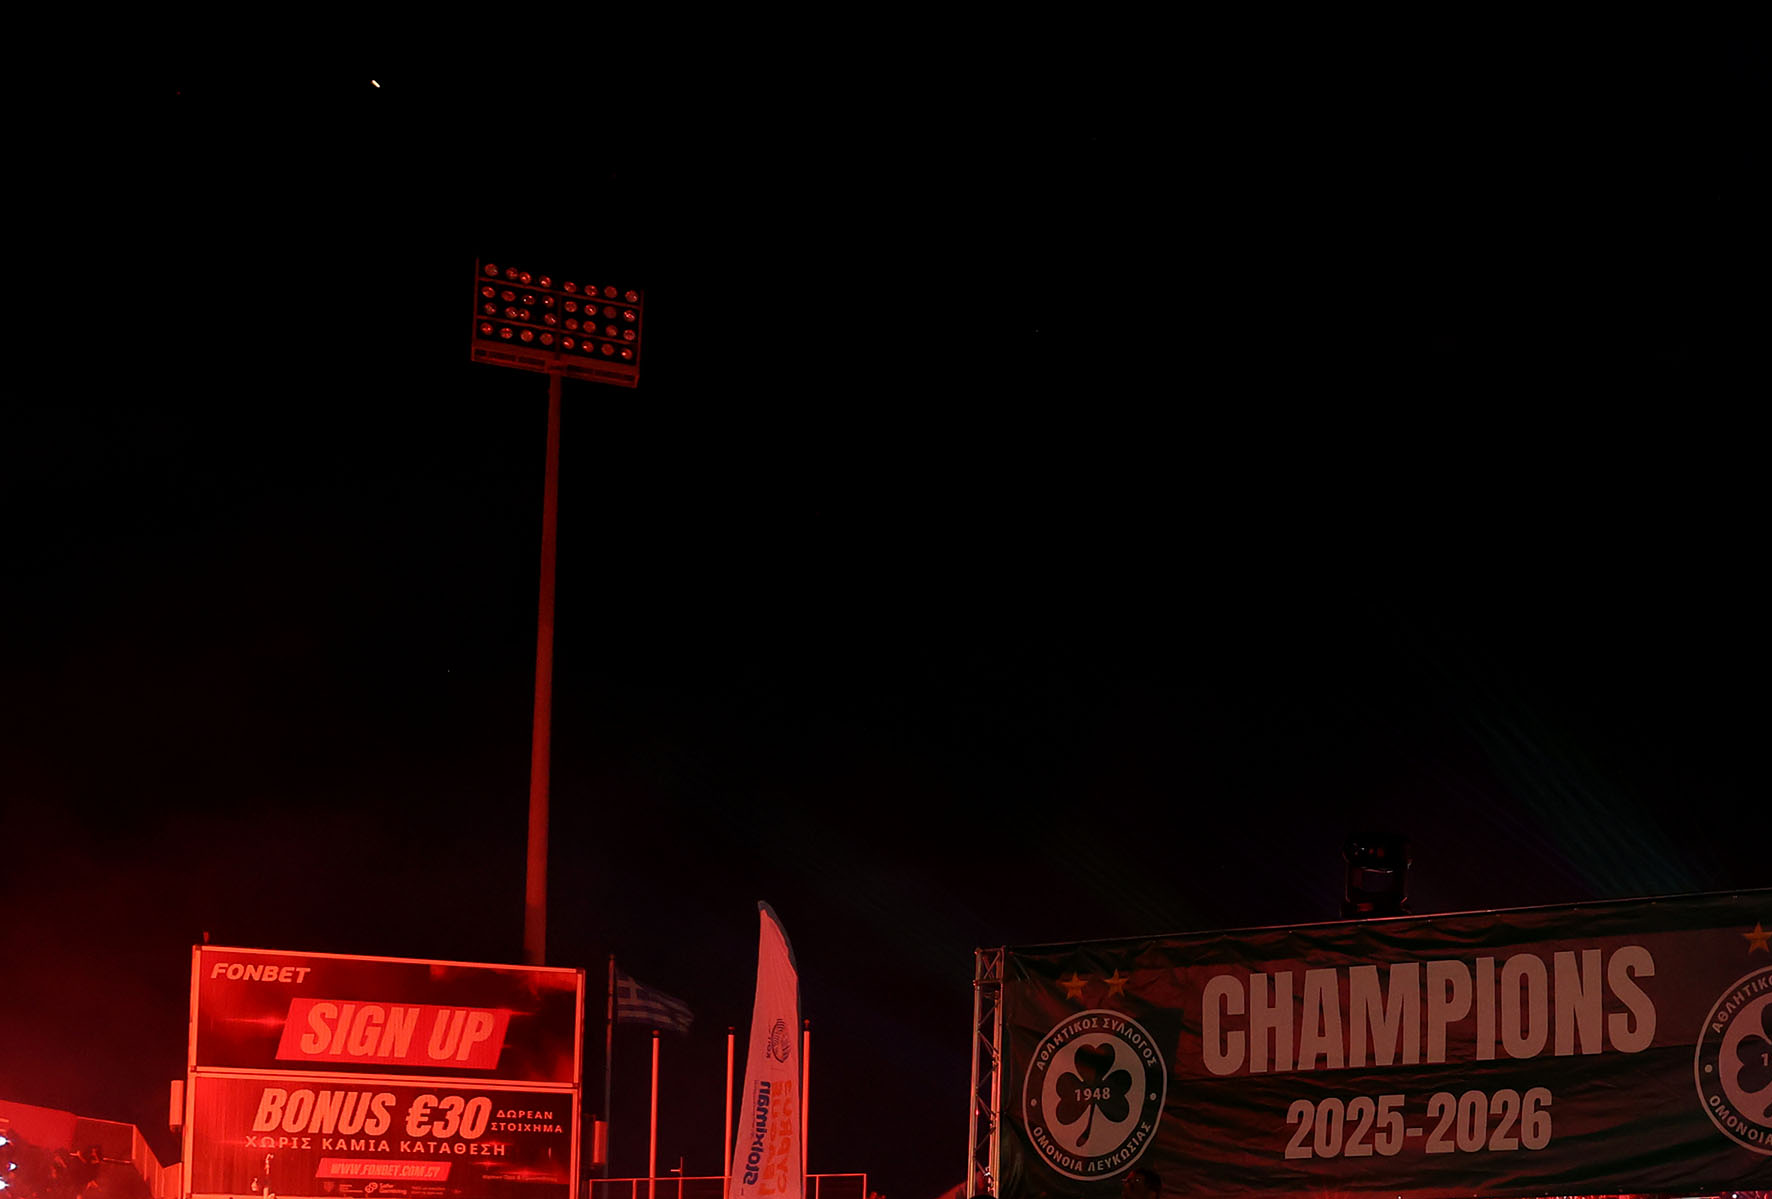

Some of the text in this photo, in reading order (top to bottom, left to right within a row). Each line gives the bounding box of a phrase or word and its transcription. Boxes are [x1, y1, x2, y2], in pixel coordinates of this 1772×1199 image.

[210, 962, 311, 984] FONBET
[300, 1002, 495, 1062] SIGN UP
[1202, 945, 1657, 1075] CHAMPIONS
[1037, 1017, 1158, 1072] ΑΘΛΗΤΙΚΟΣ ΣΥΛΛΟΓΟΣ
[252, 1088, 492, 1139] BONUS €30
[496, 1109, 553, 1121] ΔΩΡΕΑΝ
[1074, 1086, 1111, 1102] 1948
[245, 1135, 506, 1156] ΧΩΡΙΣ ΚΑΜΙΑ ΚΑΤΑΘΕΣΗ
[491, 1121, 563, 1134] ΣΤΟΙΧΗΜΑ
[1033, 1121, 1152, 1173] ΟΜΟΝΟΙΑ ΛΕΥΚΩΣΙΑΣ
[1285, 1086, 1553, 1159] 2025-2026
